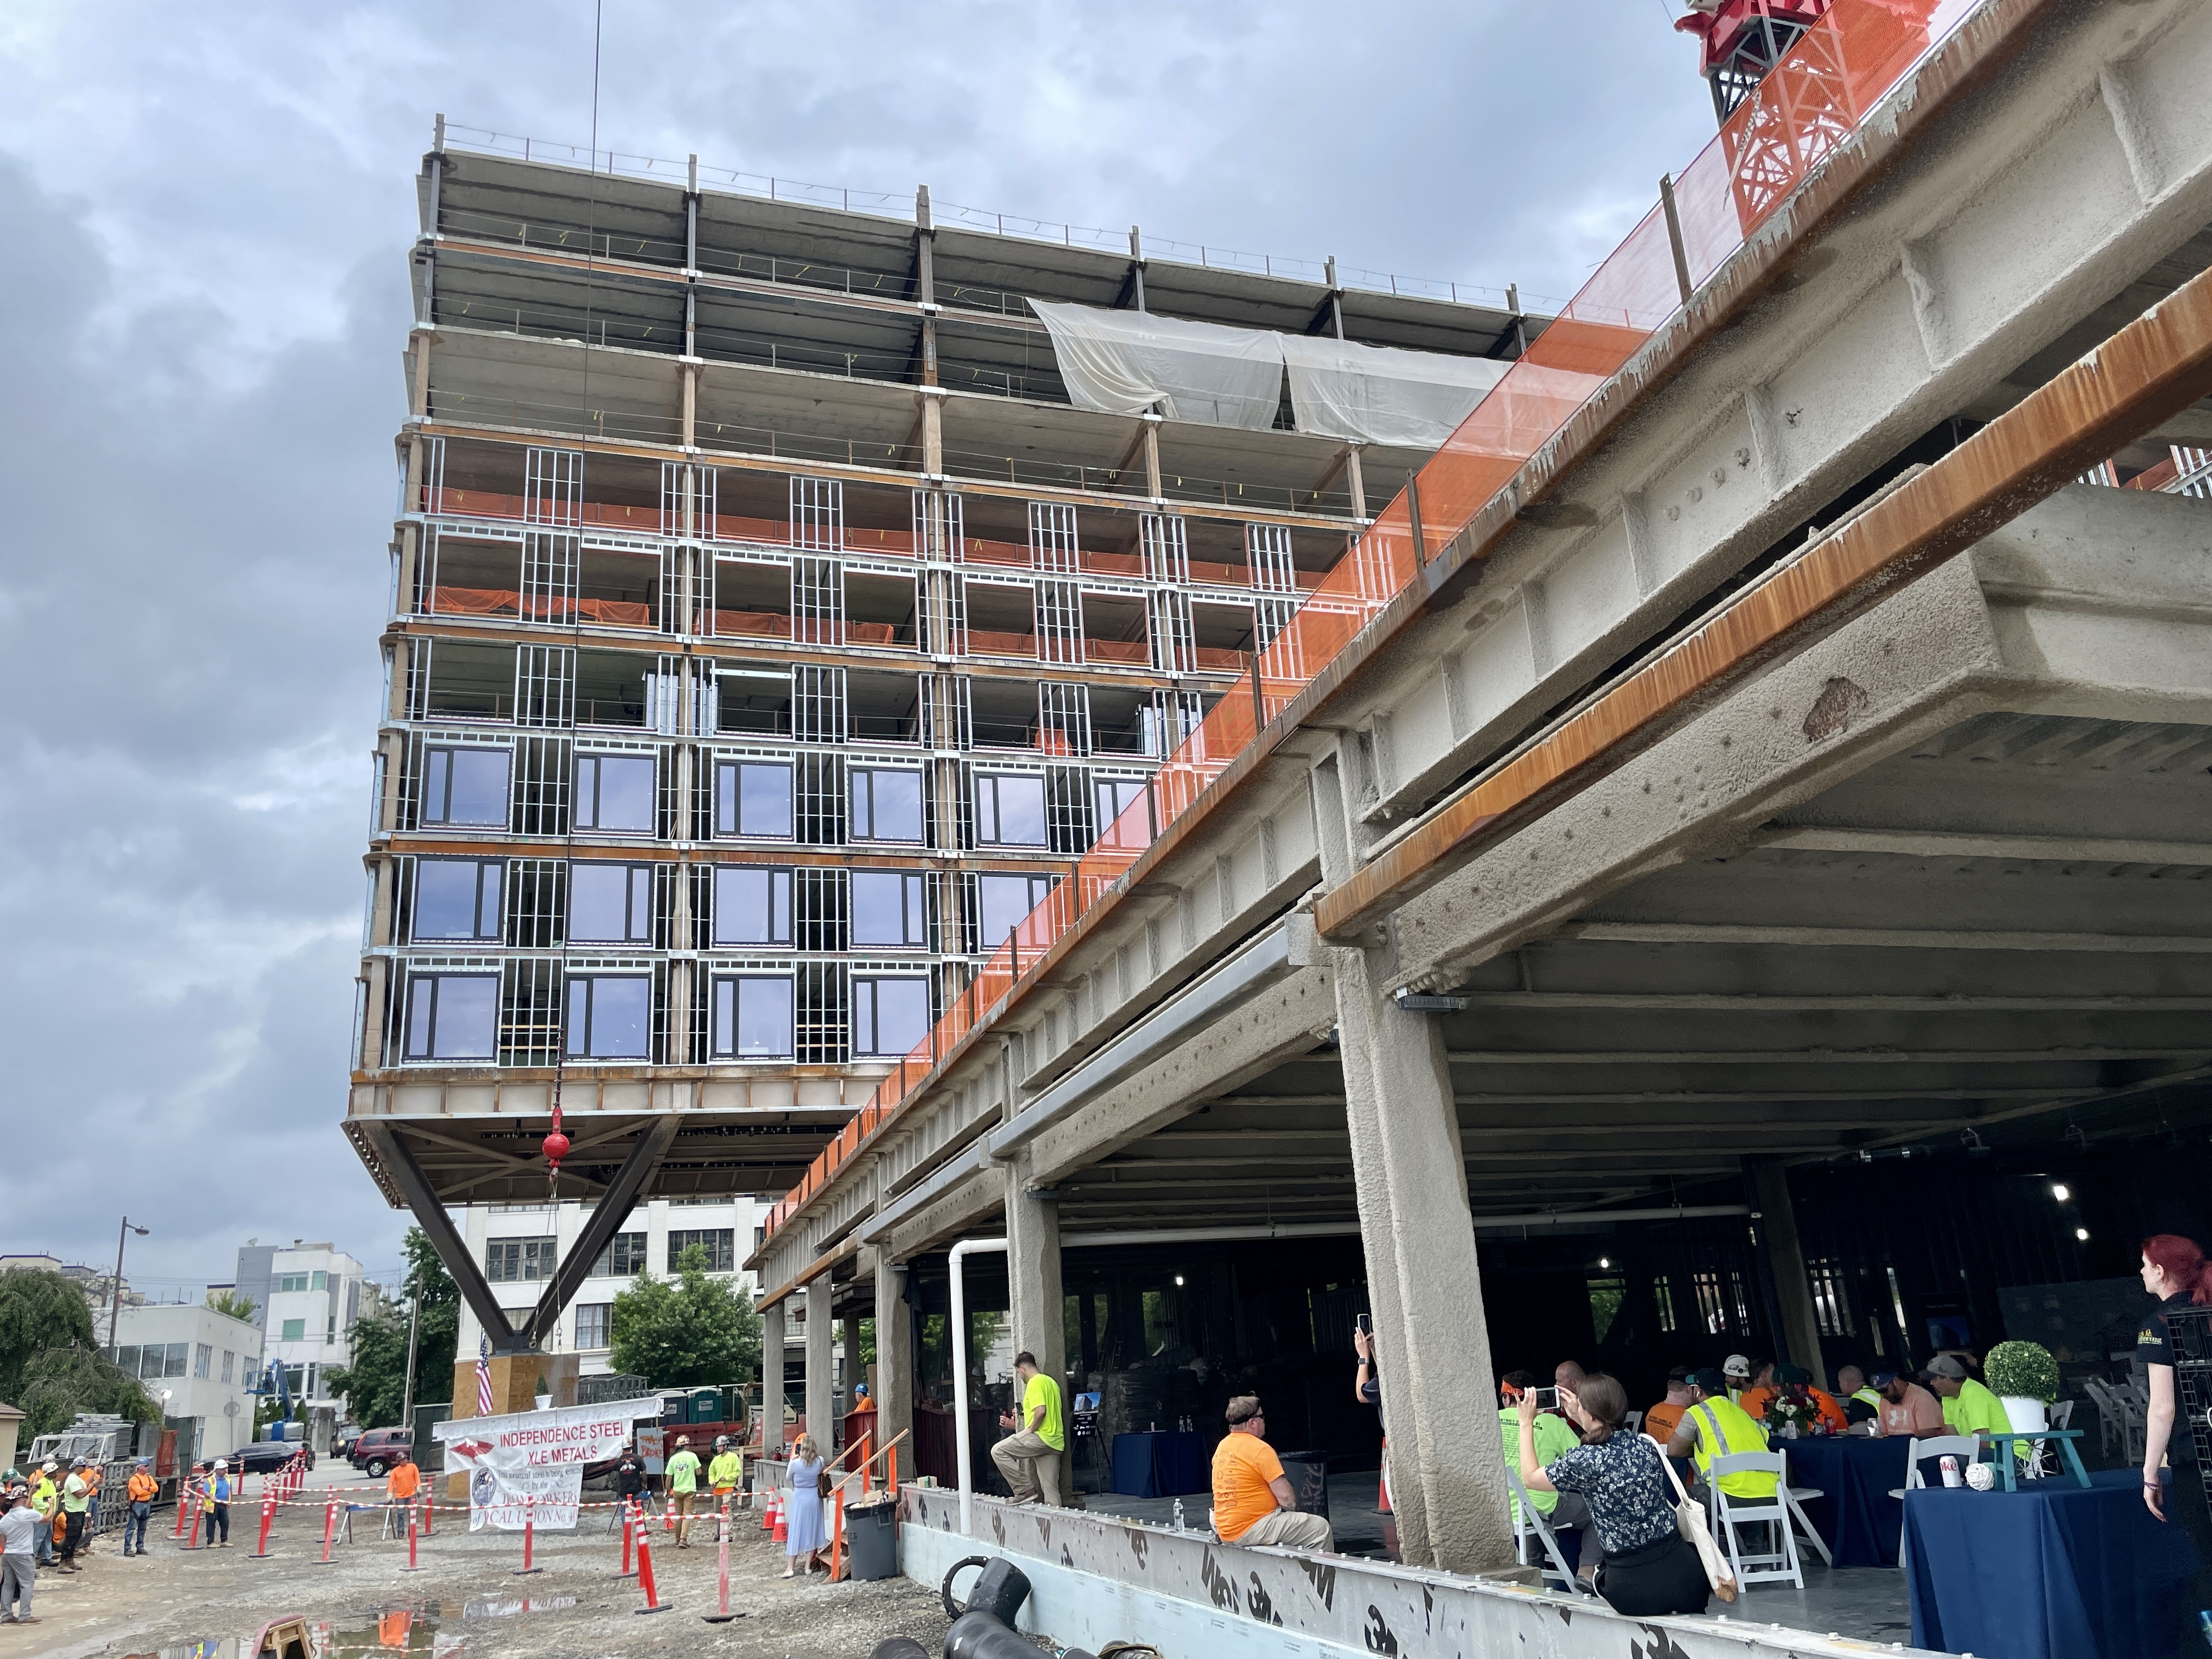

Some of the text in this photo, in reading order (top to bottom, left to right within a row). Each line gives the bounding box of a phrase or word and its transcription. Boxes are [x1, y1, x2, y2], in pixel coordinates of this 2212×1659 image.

[500, 1426, 586, 1448] INDEPENDENCE
[590, 1421, 625, 1439] STEEL
[527, 1445, 597, 1465] XLE METALS
[497, 1470, 507, 1479] This
[533, 1470, 544, 1479] steel
[551, 1469, 564, 1479] being
[532, 1480, 548, 1491] by the
[473, 1511, 482, 1527] of
[517, 1510, 552, 1523] UION
